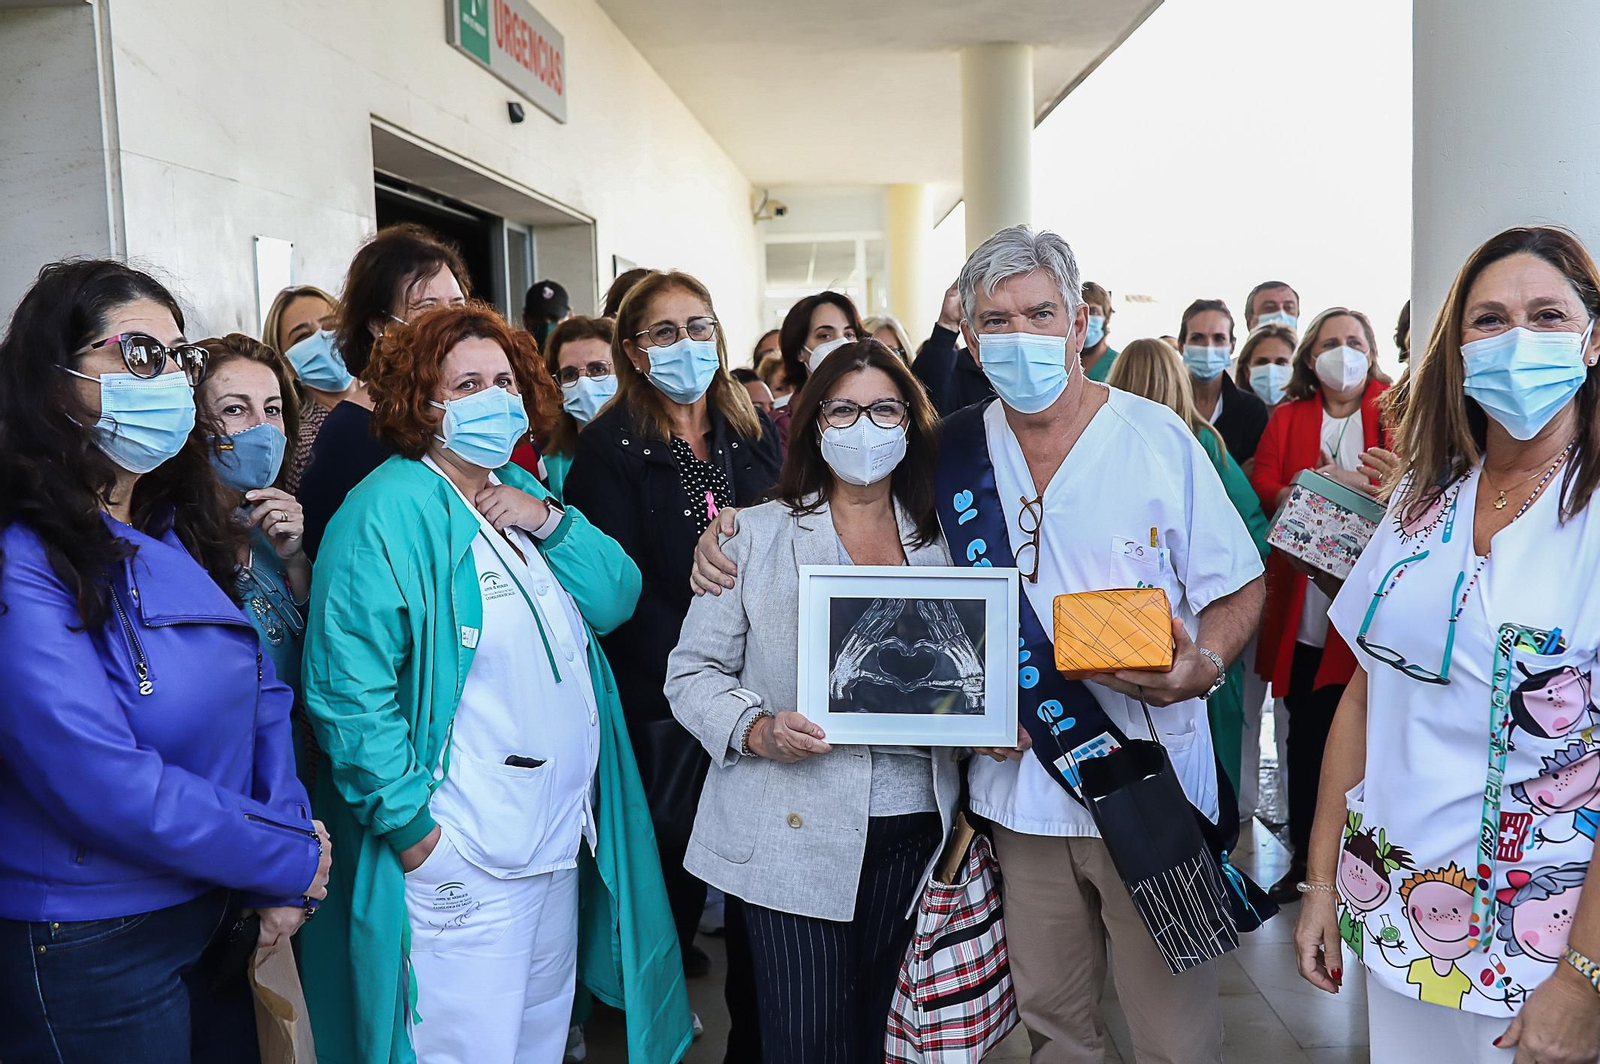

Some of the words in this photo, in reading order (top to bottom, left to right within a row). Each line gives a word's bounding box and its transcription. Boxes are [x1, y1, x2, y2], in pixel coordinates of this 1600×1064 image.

[494, 0, 563, 96] URGENCIAS
[1498, 628, 1515, 661] CSIF
[1480, 825, 1494, 860] CSIF
